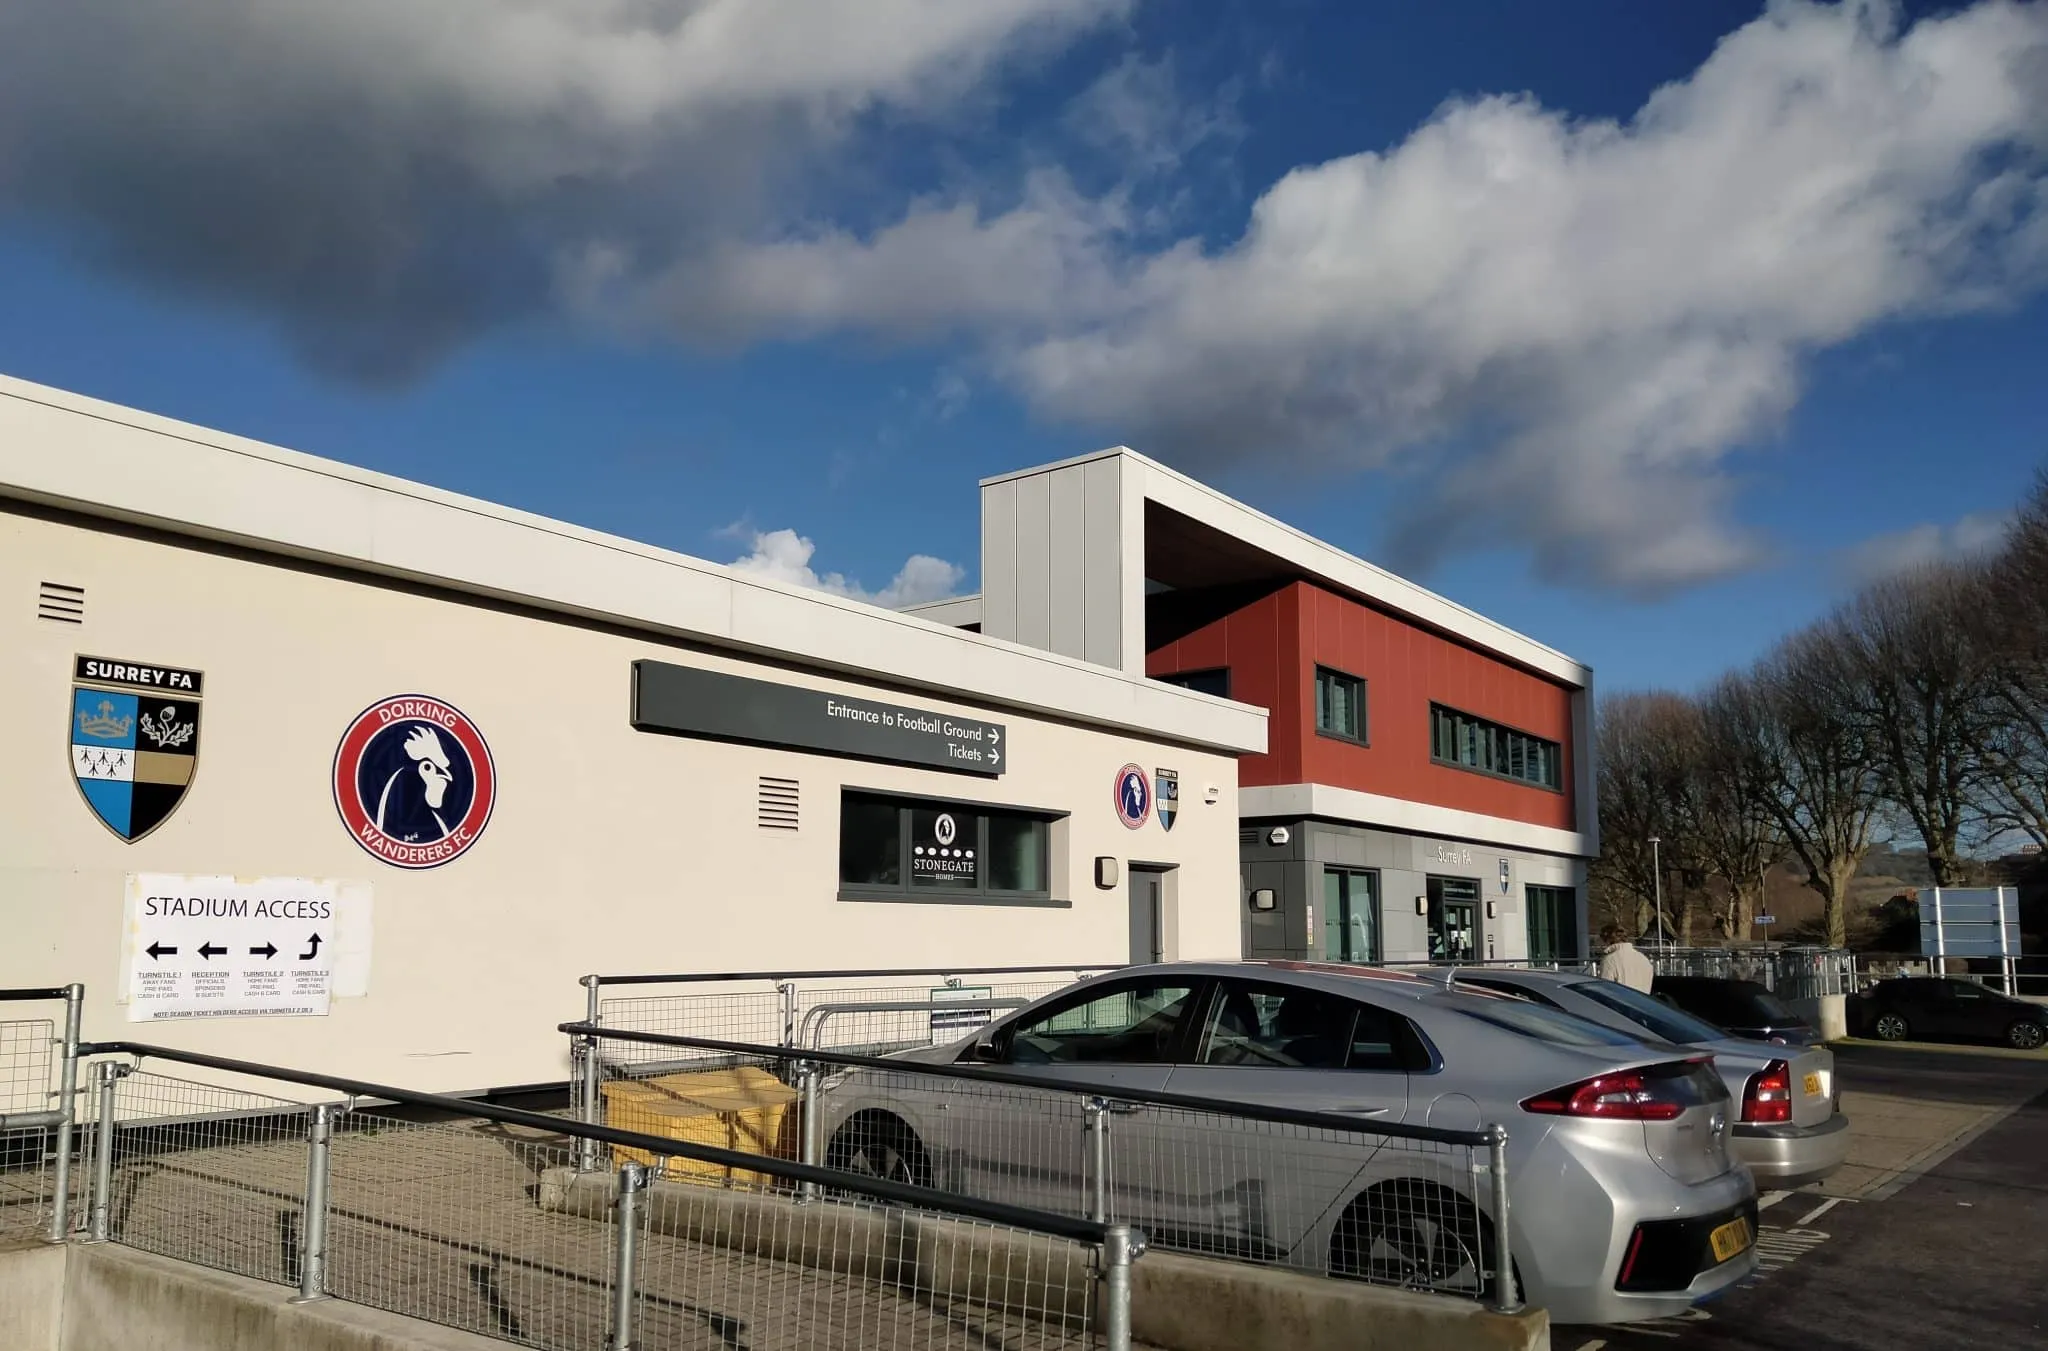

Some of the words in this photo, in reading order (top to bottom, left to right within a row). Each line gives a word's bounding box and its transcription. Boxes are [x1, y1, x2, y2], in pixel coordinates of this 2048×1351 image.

[86, 661, 165, 684] SURREY
[169, 672, 192, 689] FA
[378, 702, 457, 728] DORKING
[827, 701, 879, 724] Entrance
[882, 712, 894, 726] to
[897, 713, 941, 735] Football
[943, 722, 982, 741] Ground
[948, 743, 982, 761] Tickets
[360, 824, 453, 862] WANDERERS
[453, 827, 471, 847] FC
[914, 859, 974, 872] STONEGATE
[1438, 845, 1460, 867] Surrey
[1462, 849, 1472, 865] FA
[145, 896, 248, 917] STADIUM
[254, 899, 331, 918] ACCESS
